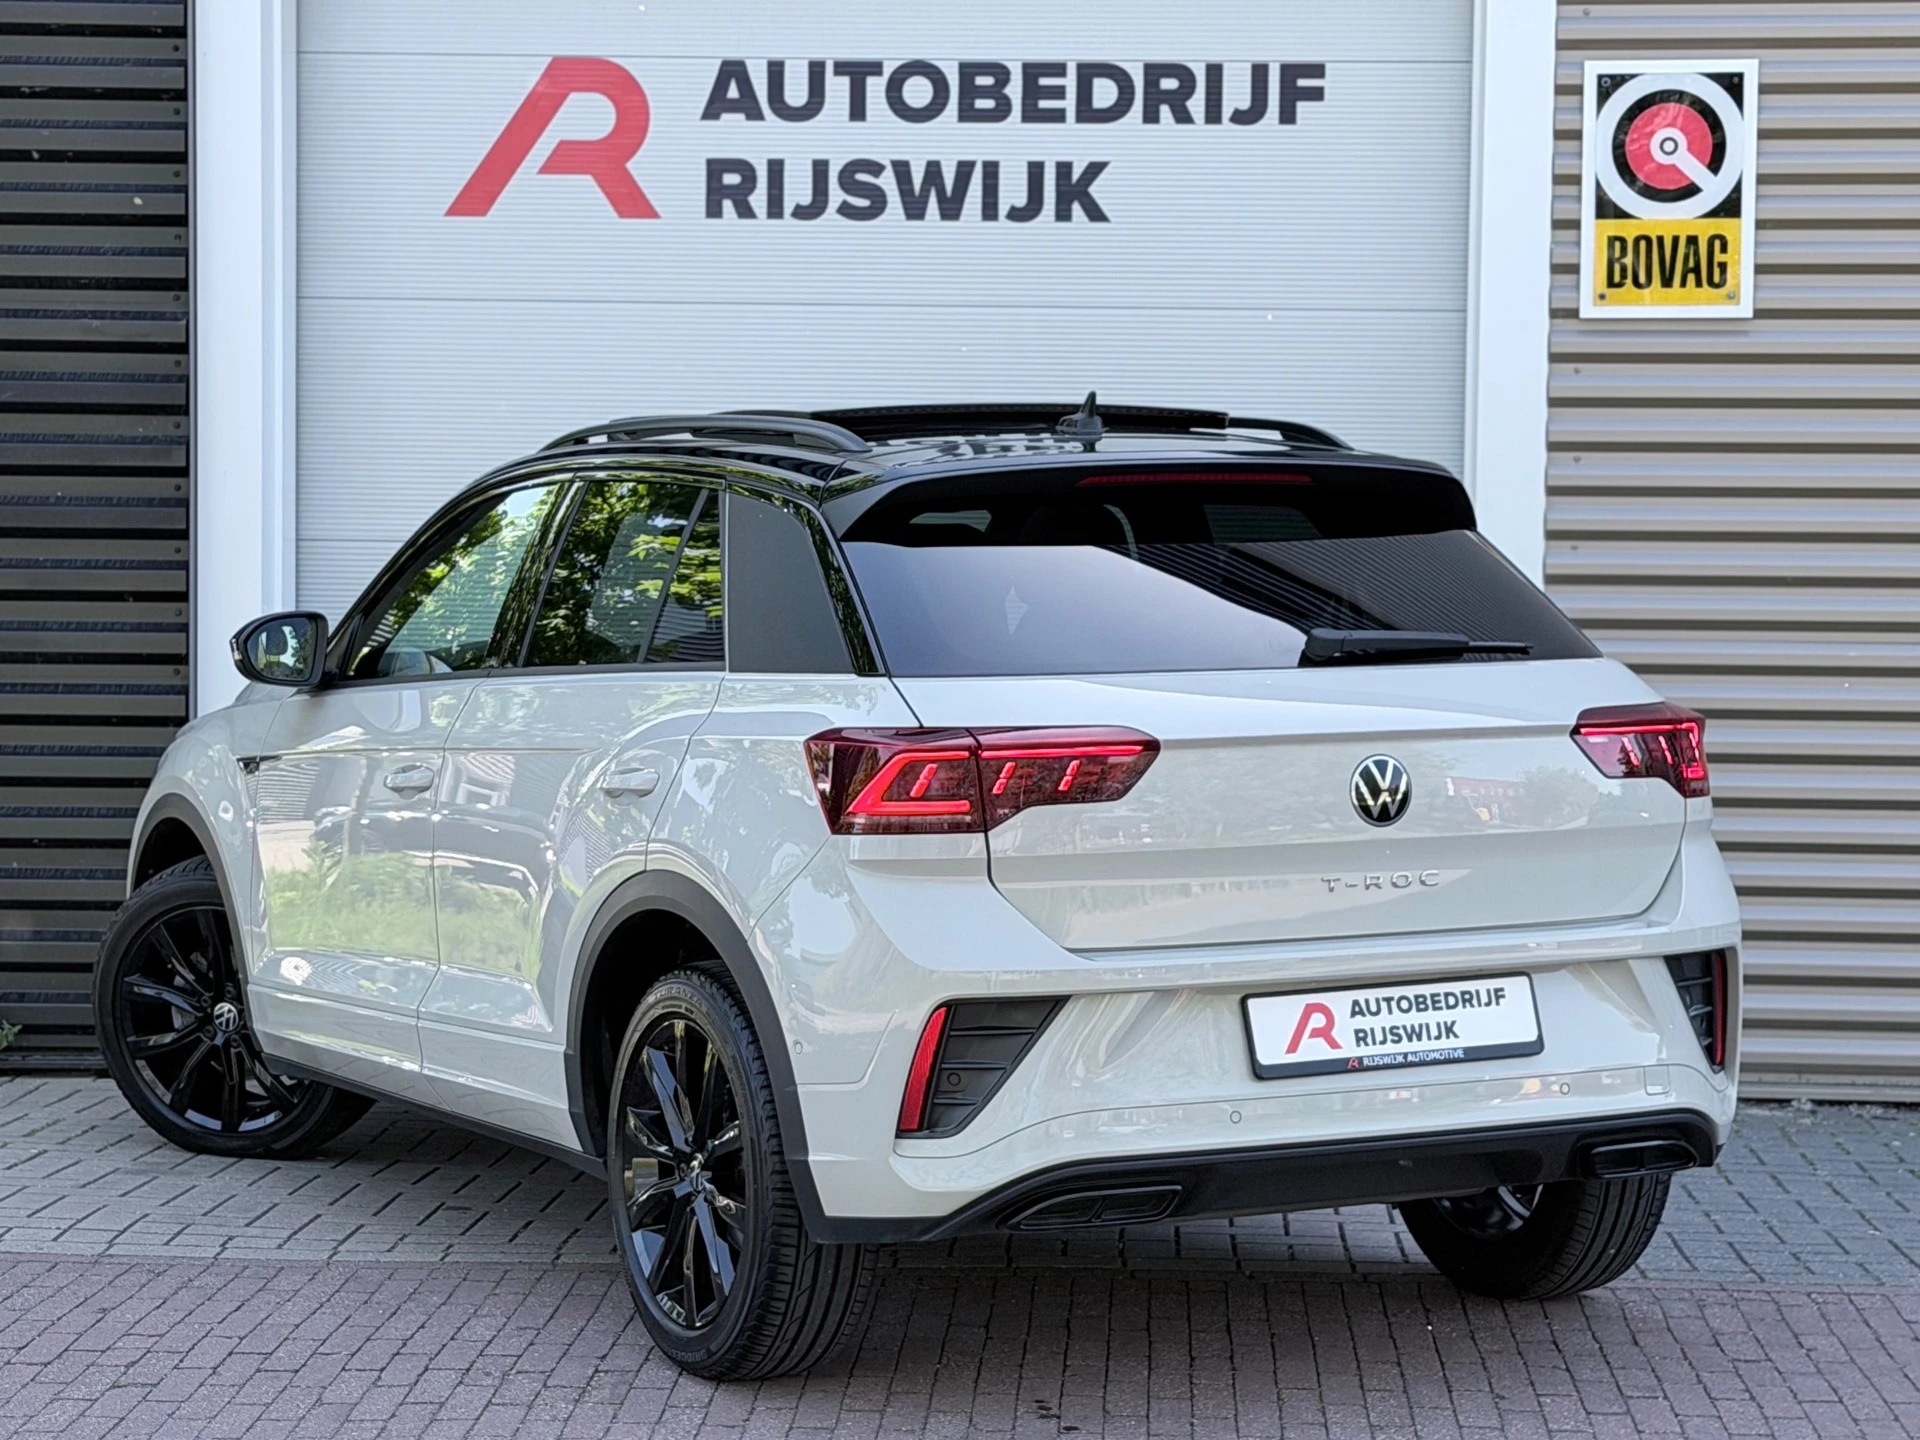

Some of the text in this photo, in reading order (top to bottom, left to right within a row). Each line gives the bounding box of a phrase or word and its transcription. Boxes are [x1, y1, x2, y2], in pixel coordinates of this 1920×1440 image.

[700, 59, 1327, 126] AUTOBEDRIJF
[704, 157, 1111, 223] RIJSWIJK
[1605, 233, 1729, 290] BOVAG
[1320, 869, 1440, 893] T-ROC
[1349, 987, 1507, 1019] AUTOBEDRIJF
[1353, 1020, 1460, 1048] RIJSWIJK
[1362, 1053, 1406, 1067] RIJSWIJK
[1407, 1048, 1465, 1063] AUTOMOTIVE
